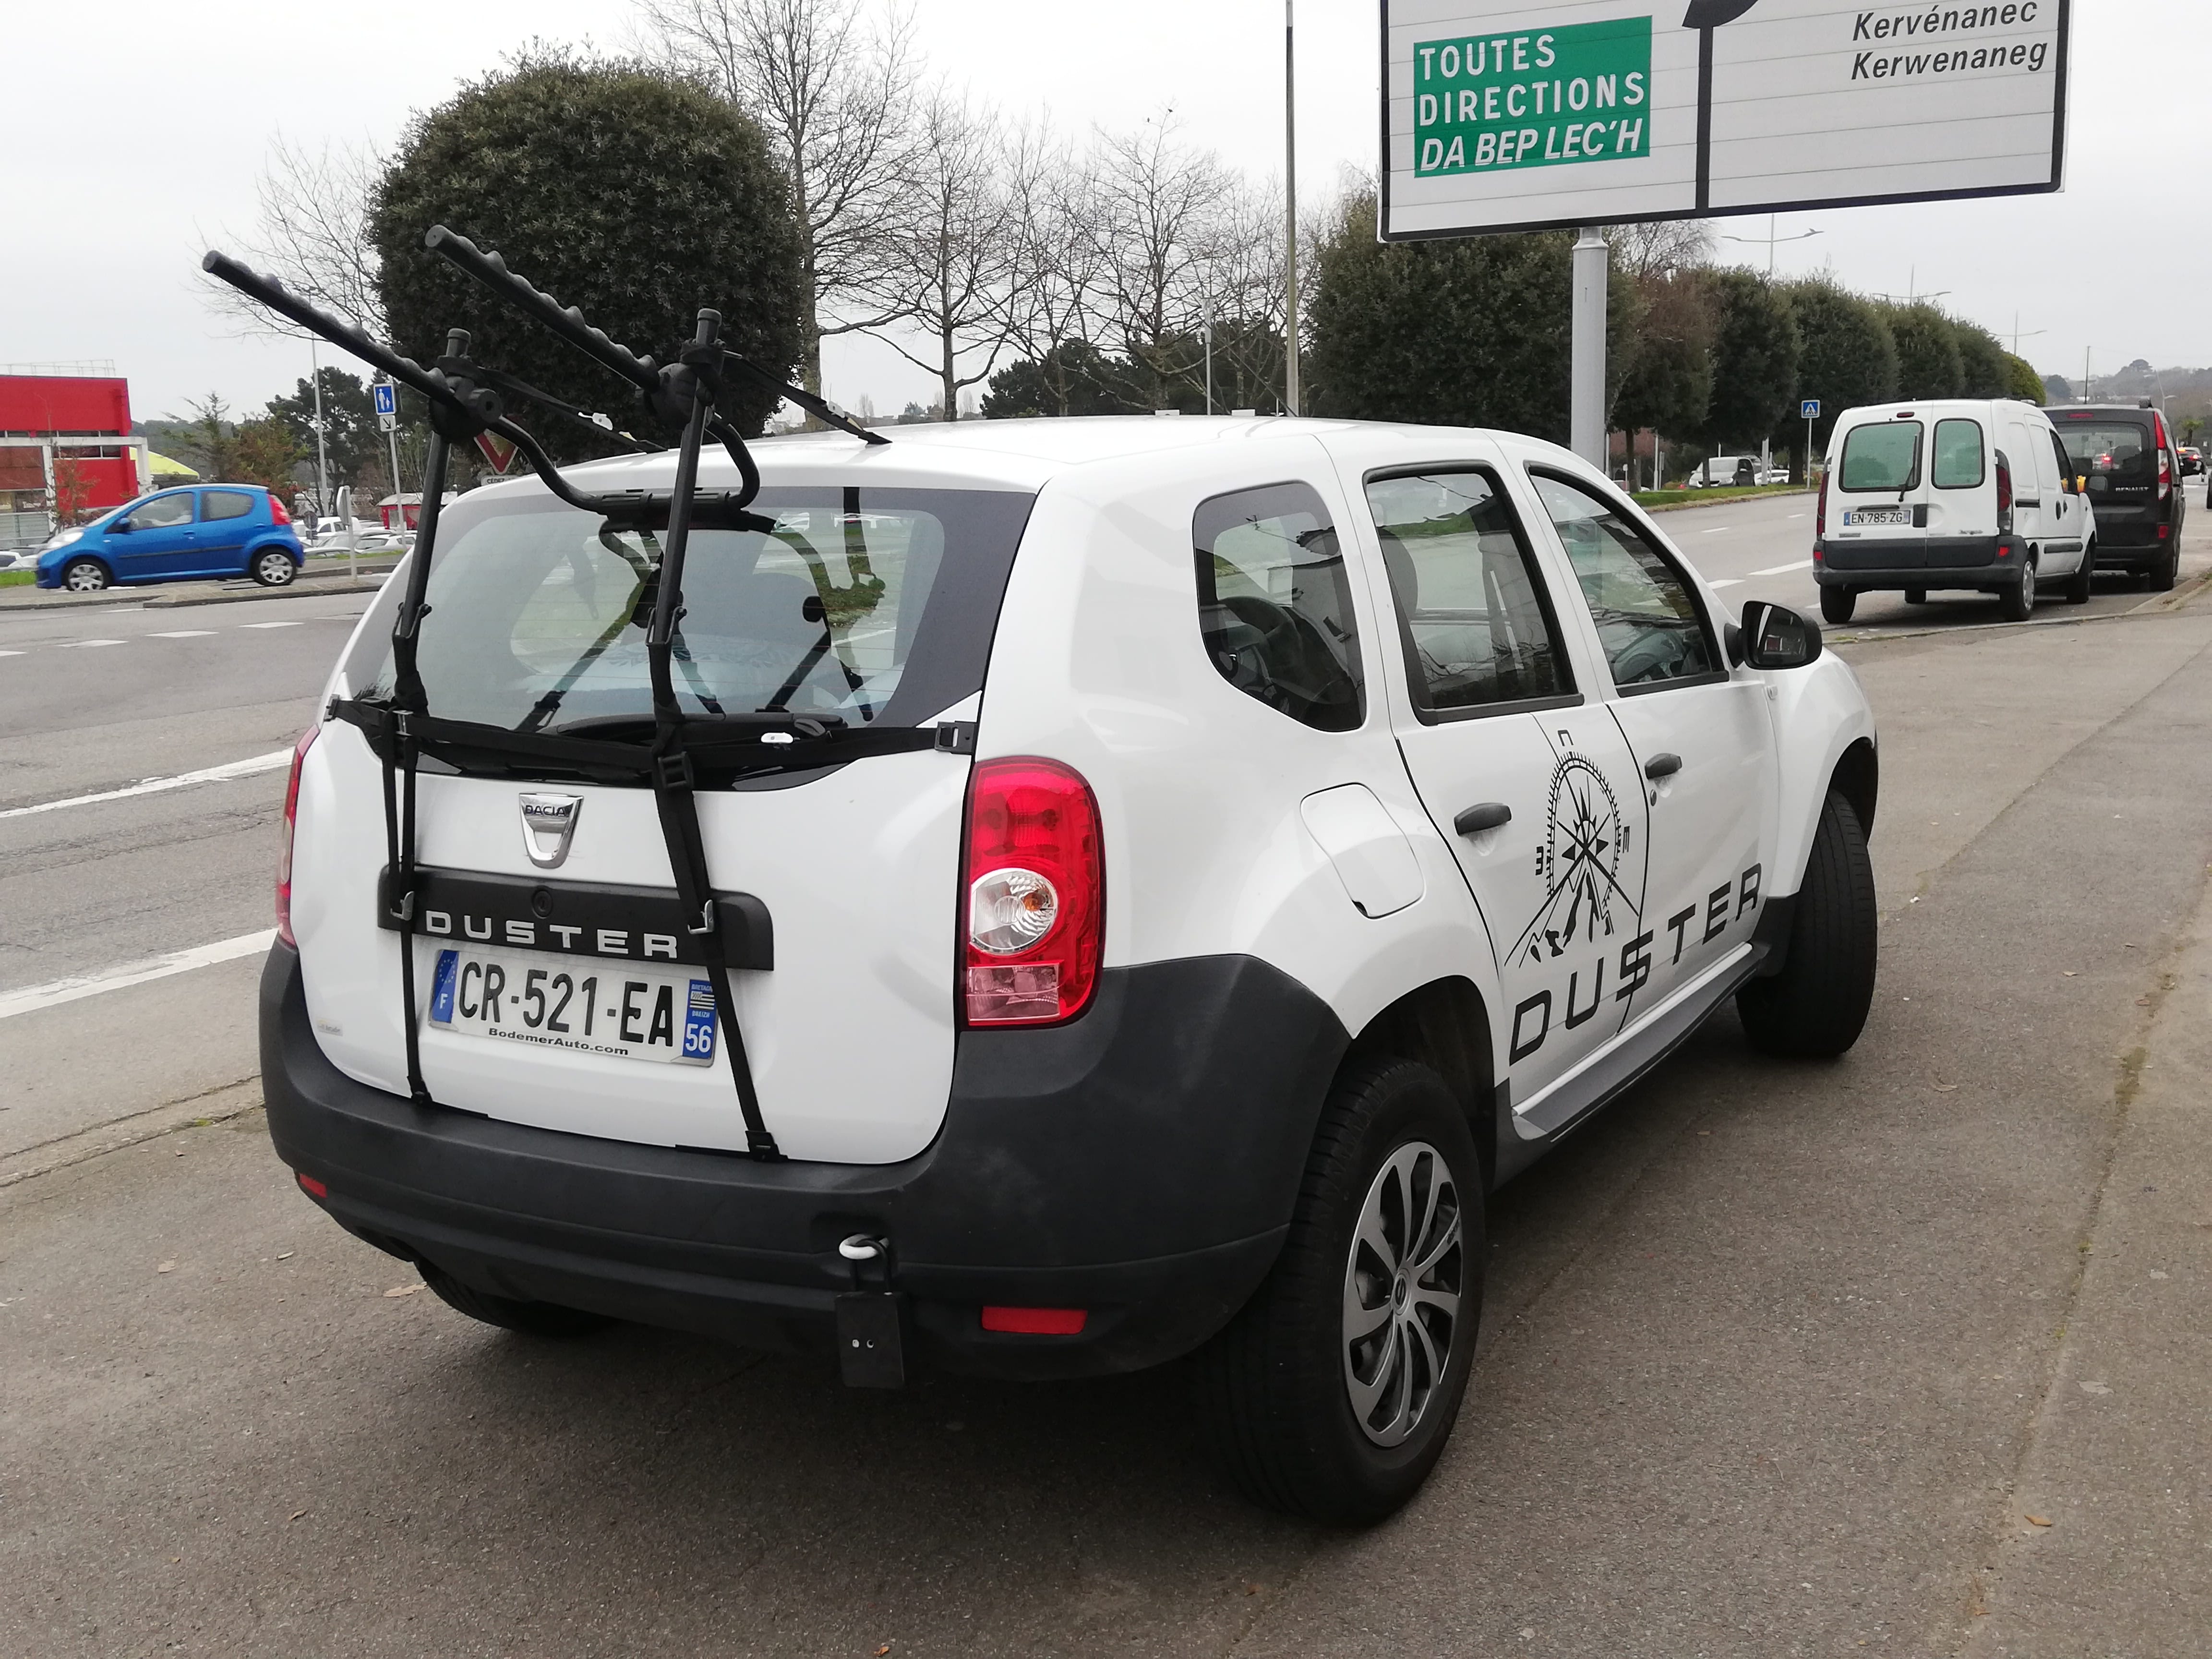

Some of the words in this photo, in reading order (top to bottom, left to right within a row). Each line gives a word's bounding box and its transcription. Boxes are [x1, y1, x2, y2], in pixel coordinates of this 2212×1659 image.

[1852, 1, 2038, 41] Kervénanec
[1419, 34, 1556, 81] TOUTES
[1851, 42, 2048, 80] Kerwenaneg
[1419, 71, 1645, 127] DIRECTIONS
[1420, 135, 1465, 171] DA
[1474, 128, 1539, 167] BEP
[1544, 118, 1643, 159] LEC'H
[524, 804, 567, 817] DACIA
[426, 910, 677, 959] DUSTER
[1509, 862, 1762, 1067] DUSTER
[439, 992, 448, 1010] F
[459, 961, 673, 1047] CR-521-EA
[488, 1027, 629, 1055] BodemerAuto.com
[685, 1023, 712, 1053] 56
